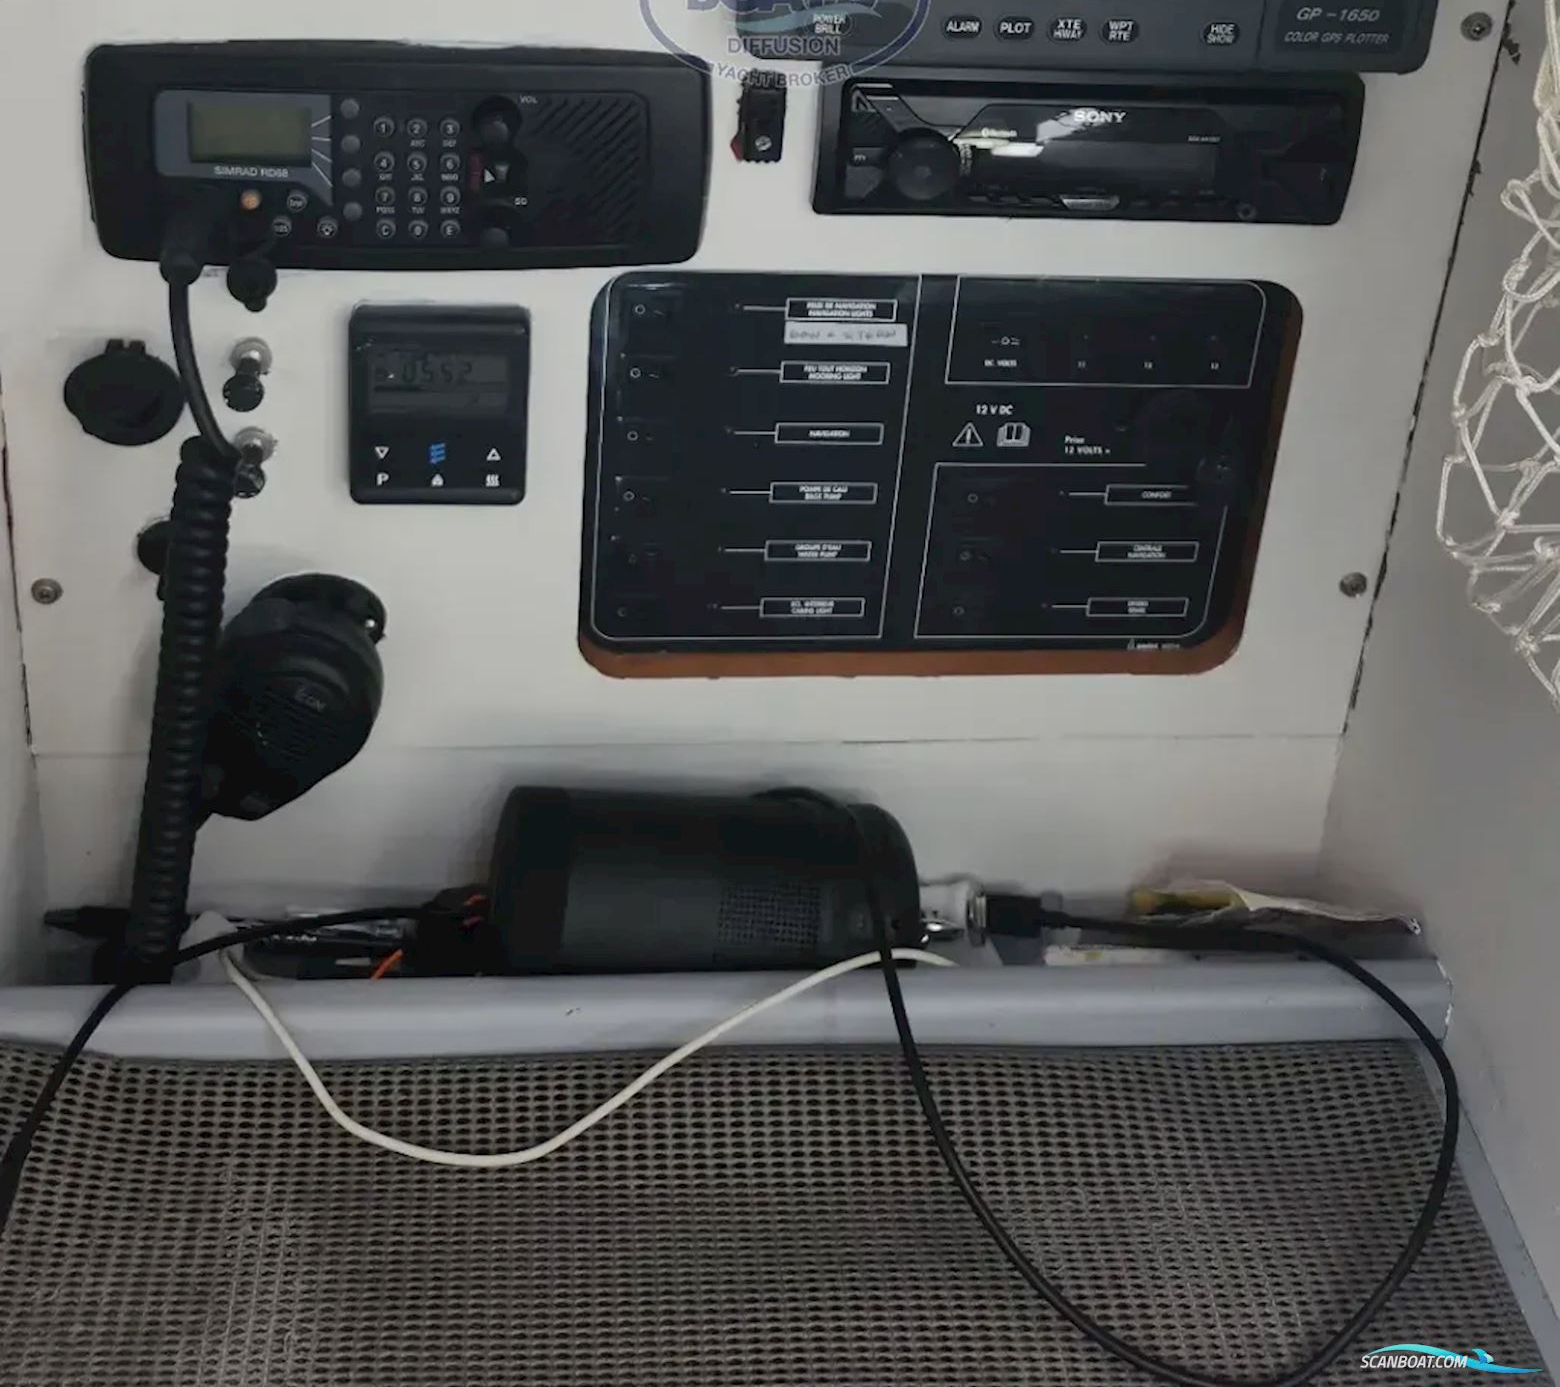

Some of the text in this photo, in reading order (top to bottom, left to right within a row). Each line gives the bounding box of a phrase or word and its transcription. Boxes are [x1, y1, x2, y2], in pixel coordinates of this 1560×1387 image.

[814, 24, 842, 35] BRILL
[946, 22, 981, 33] ALARM
[1000, 22, 1032, 34] PLOT
[1057, 19, 1082, 29] XTE
[1108, 21, 1133, 31] WPT
[1210, 24, 1235, 34] HIDE
[1109, 31, 1131, 41] RTE
[1207, 33, 1235, 44] SHOW
[1284, 31, 1390, 45] COLOR GPS PLOTTER
[1074, 110, 1127, 123] SONY
[214, 166, 258, 177] SIMRAD
[976, 405, 1014, 415] 12 V DC
[1065, 446, 1103, 454] 12 VOLTS
[377, 472, 389, 486] P
